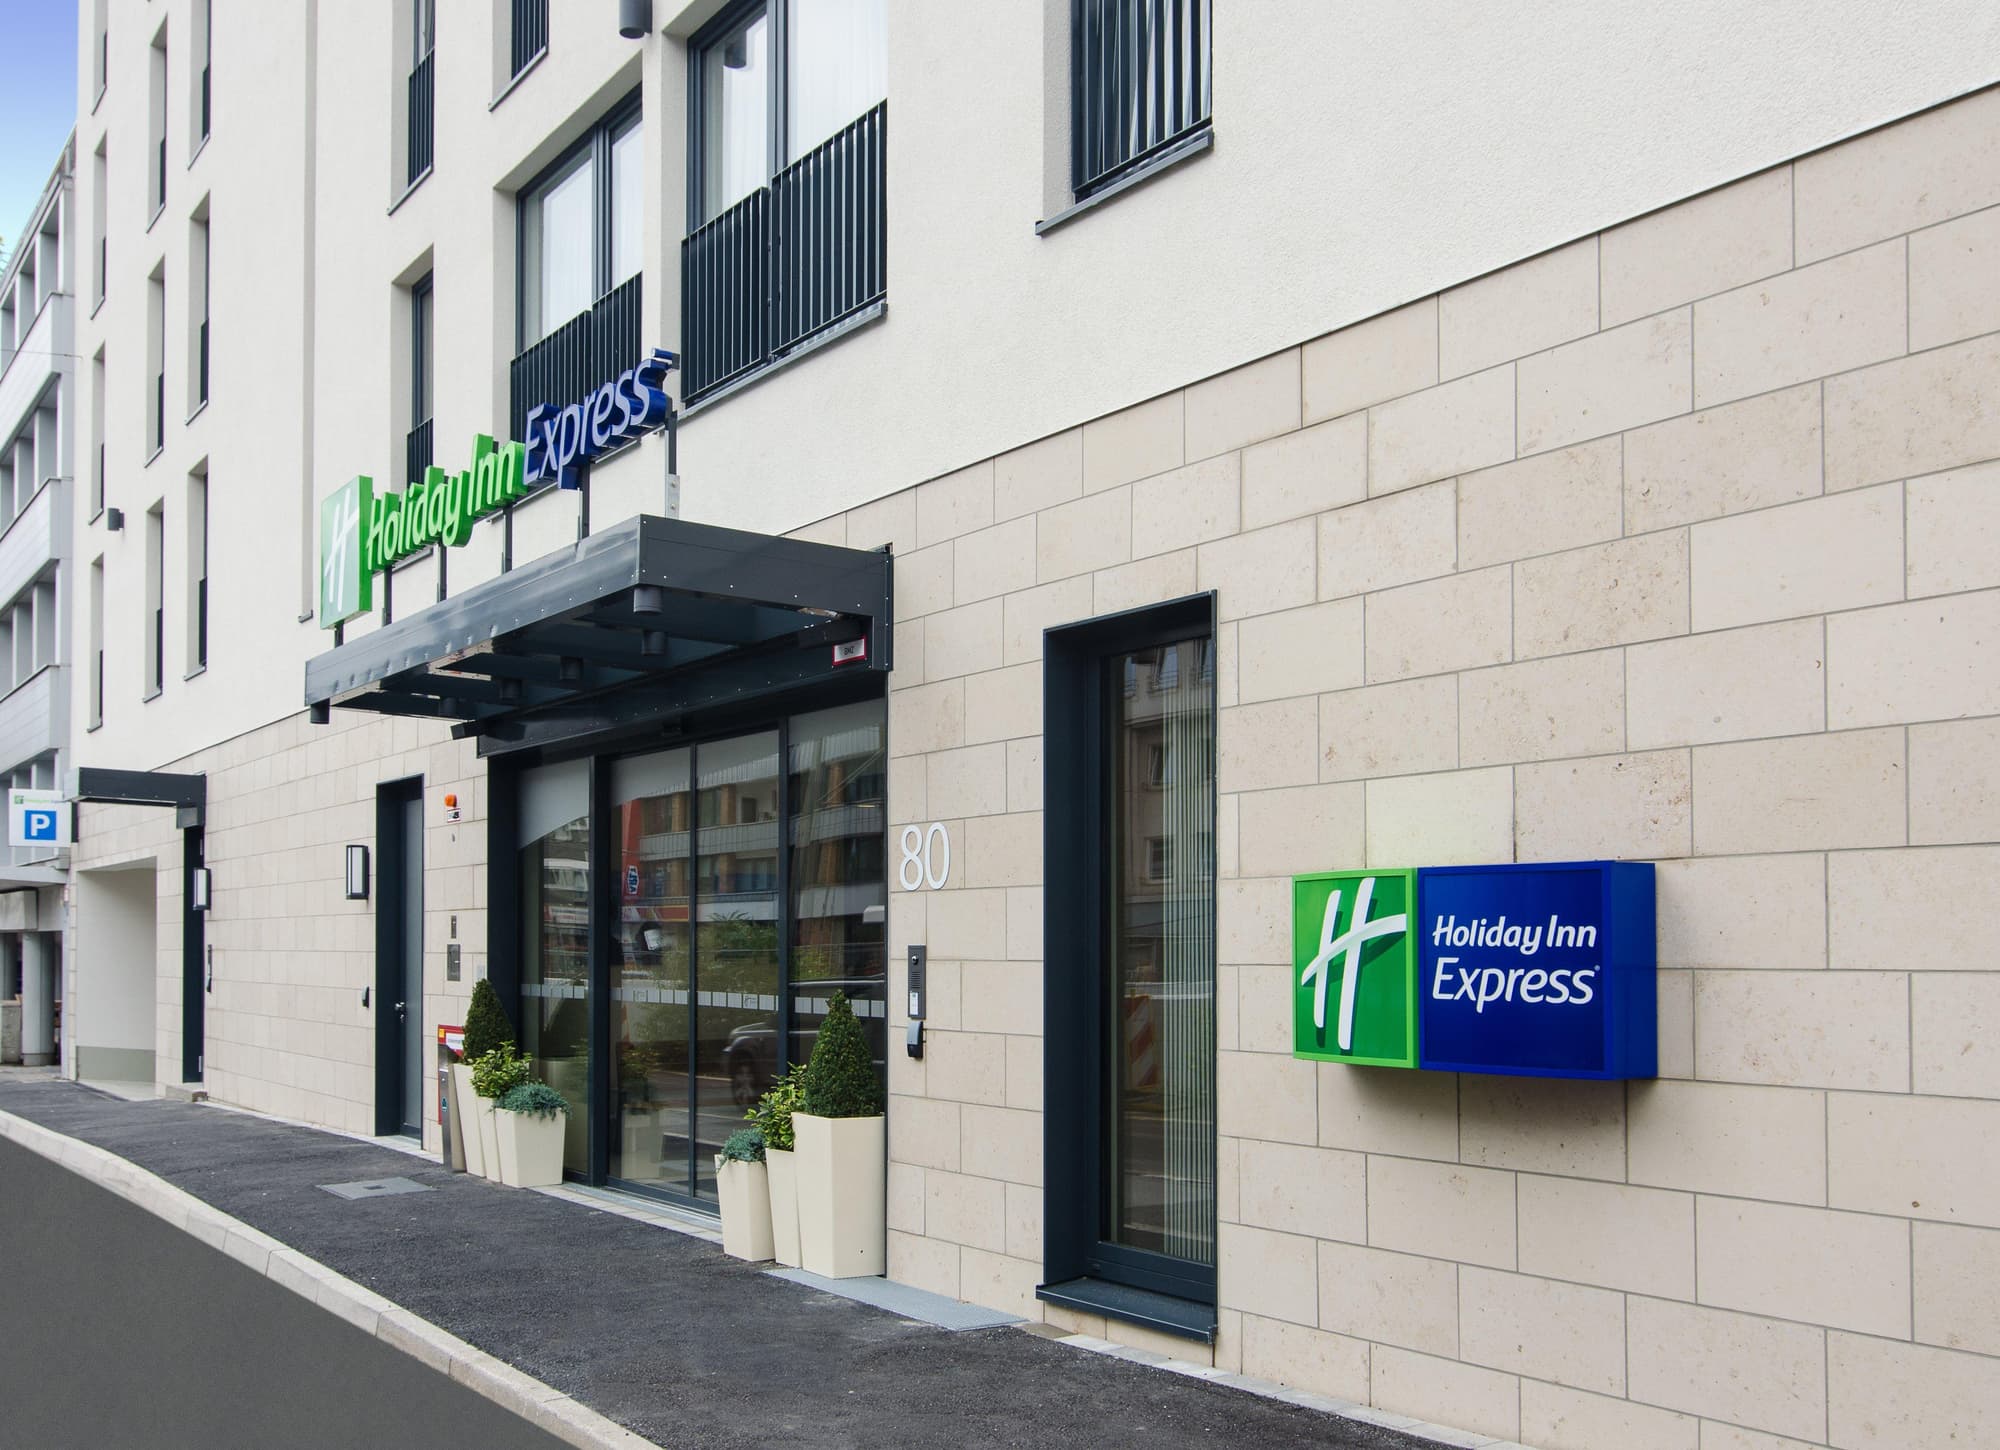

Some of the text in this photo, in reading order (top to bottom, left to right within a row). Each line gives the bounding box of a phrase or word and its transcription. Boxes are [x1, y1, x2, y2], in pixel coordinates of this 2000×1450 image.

[366, 358, 664, 571] Holiday Inn Express
[30, 813, 51, 837] P
[900, 822, 950, 891] 80
[1432, 914, 1598, 955] Holiday Inn
[1432, 957, 1595, 1014] Express
